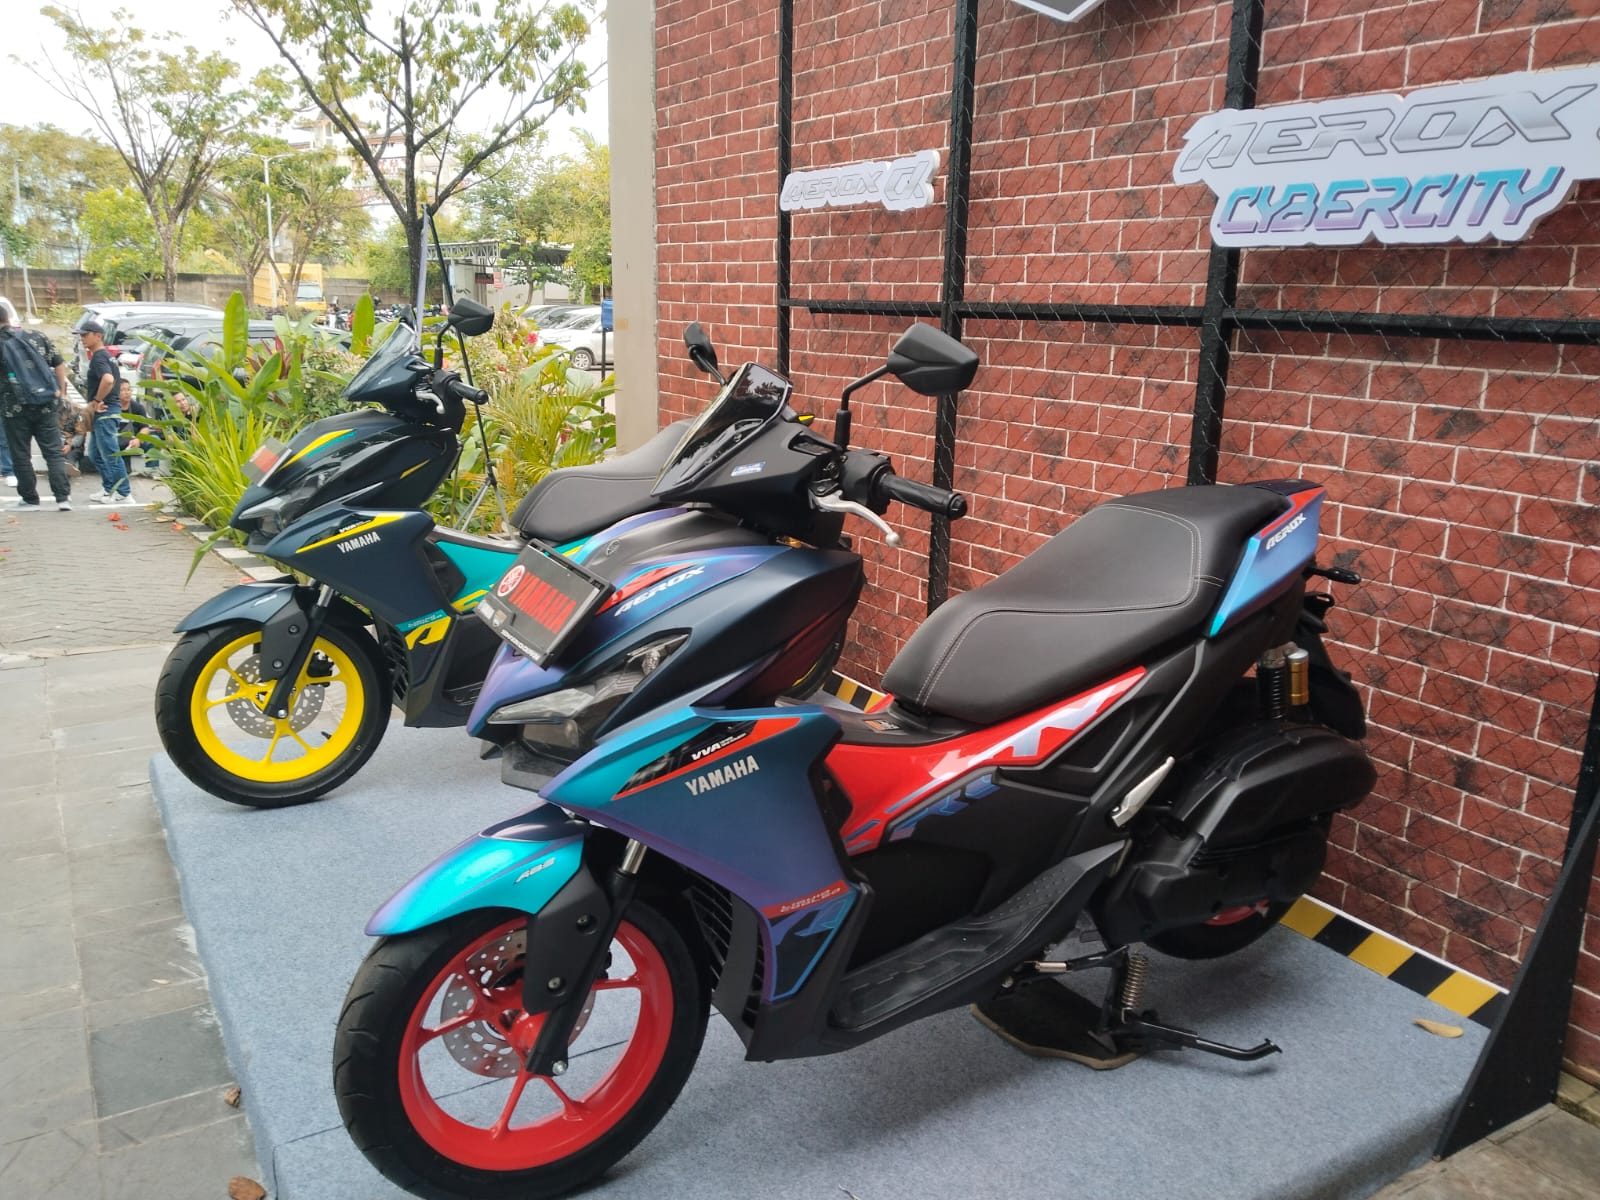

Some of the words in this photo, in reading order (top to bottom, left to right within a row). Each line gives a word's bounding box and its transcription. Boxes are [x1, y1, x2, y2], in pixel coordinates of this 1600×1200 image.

[1180, 84, 1598, 172] AEROX
[783, 170, 884, 203] AEROX
[1217, 166, 1566, 235] CYBERCITY
[337, 531, 381, 554] YAMAHA
[1265, 512, 1307, 551] AEROX
[507, 571, 577, 635] YAMAHA
[614, 565, 705, 617] AEROX
[684, 755, 760, 796] YAMAHA
